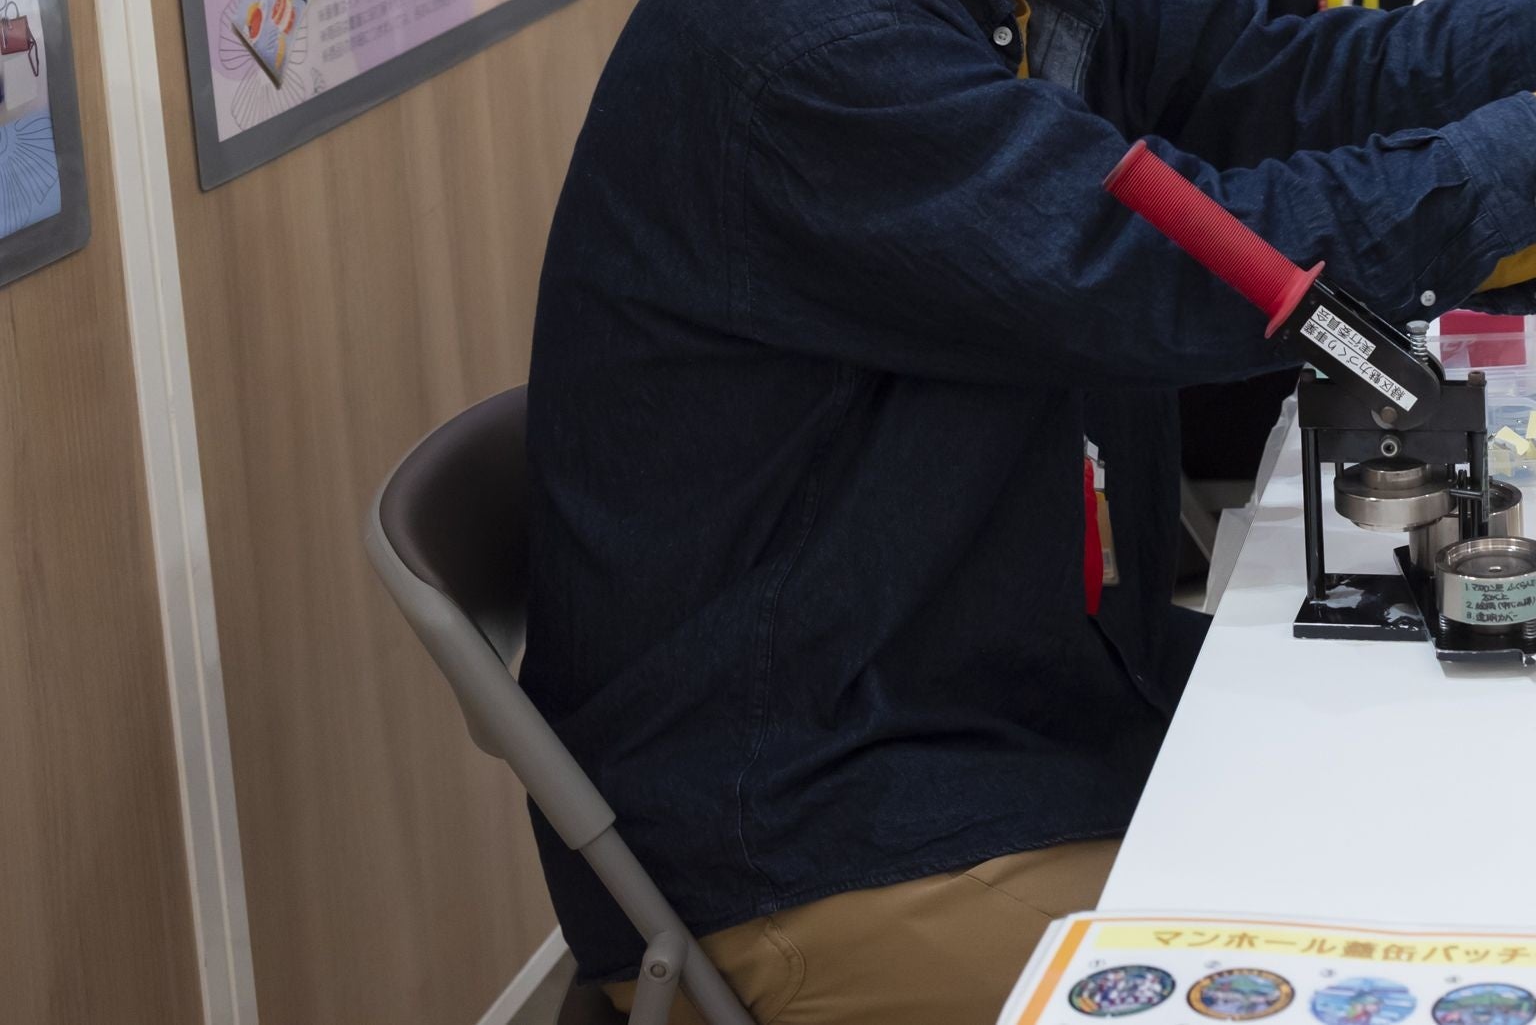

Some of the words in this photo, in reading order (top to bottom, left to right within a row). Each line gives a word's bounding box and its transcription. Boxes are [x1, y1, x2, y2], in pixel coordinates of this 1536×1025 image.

[1303, 320, 1405, 401] 緑区魅力づくり事業
[1316, 307, 1374, 356] 実行委員会
